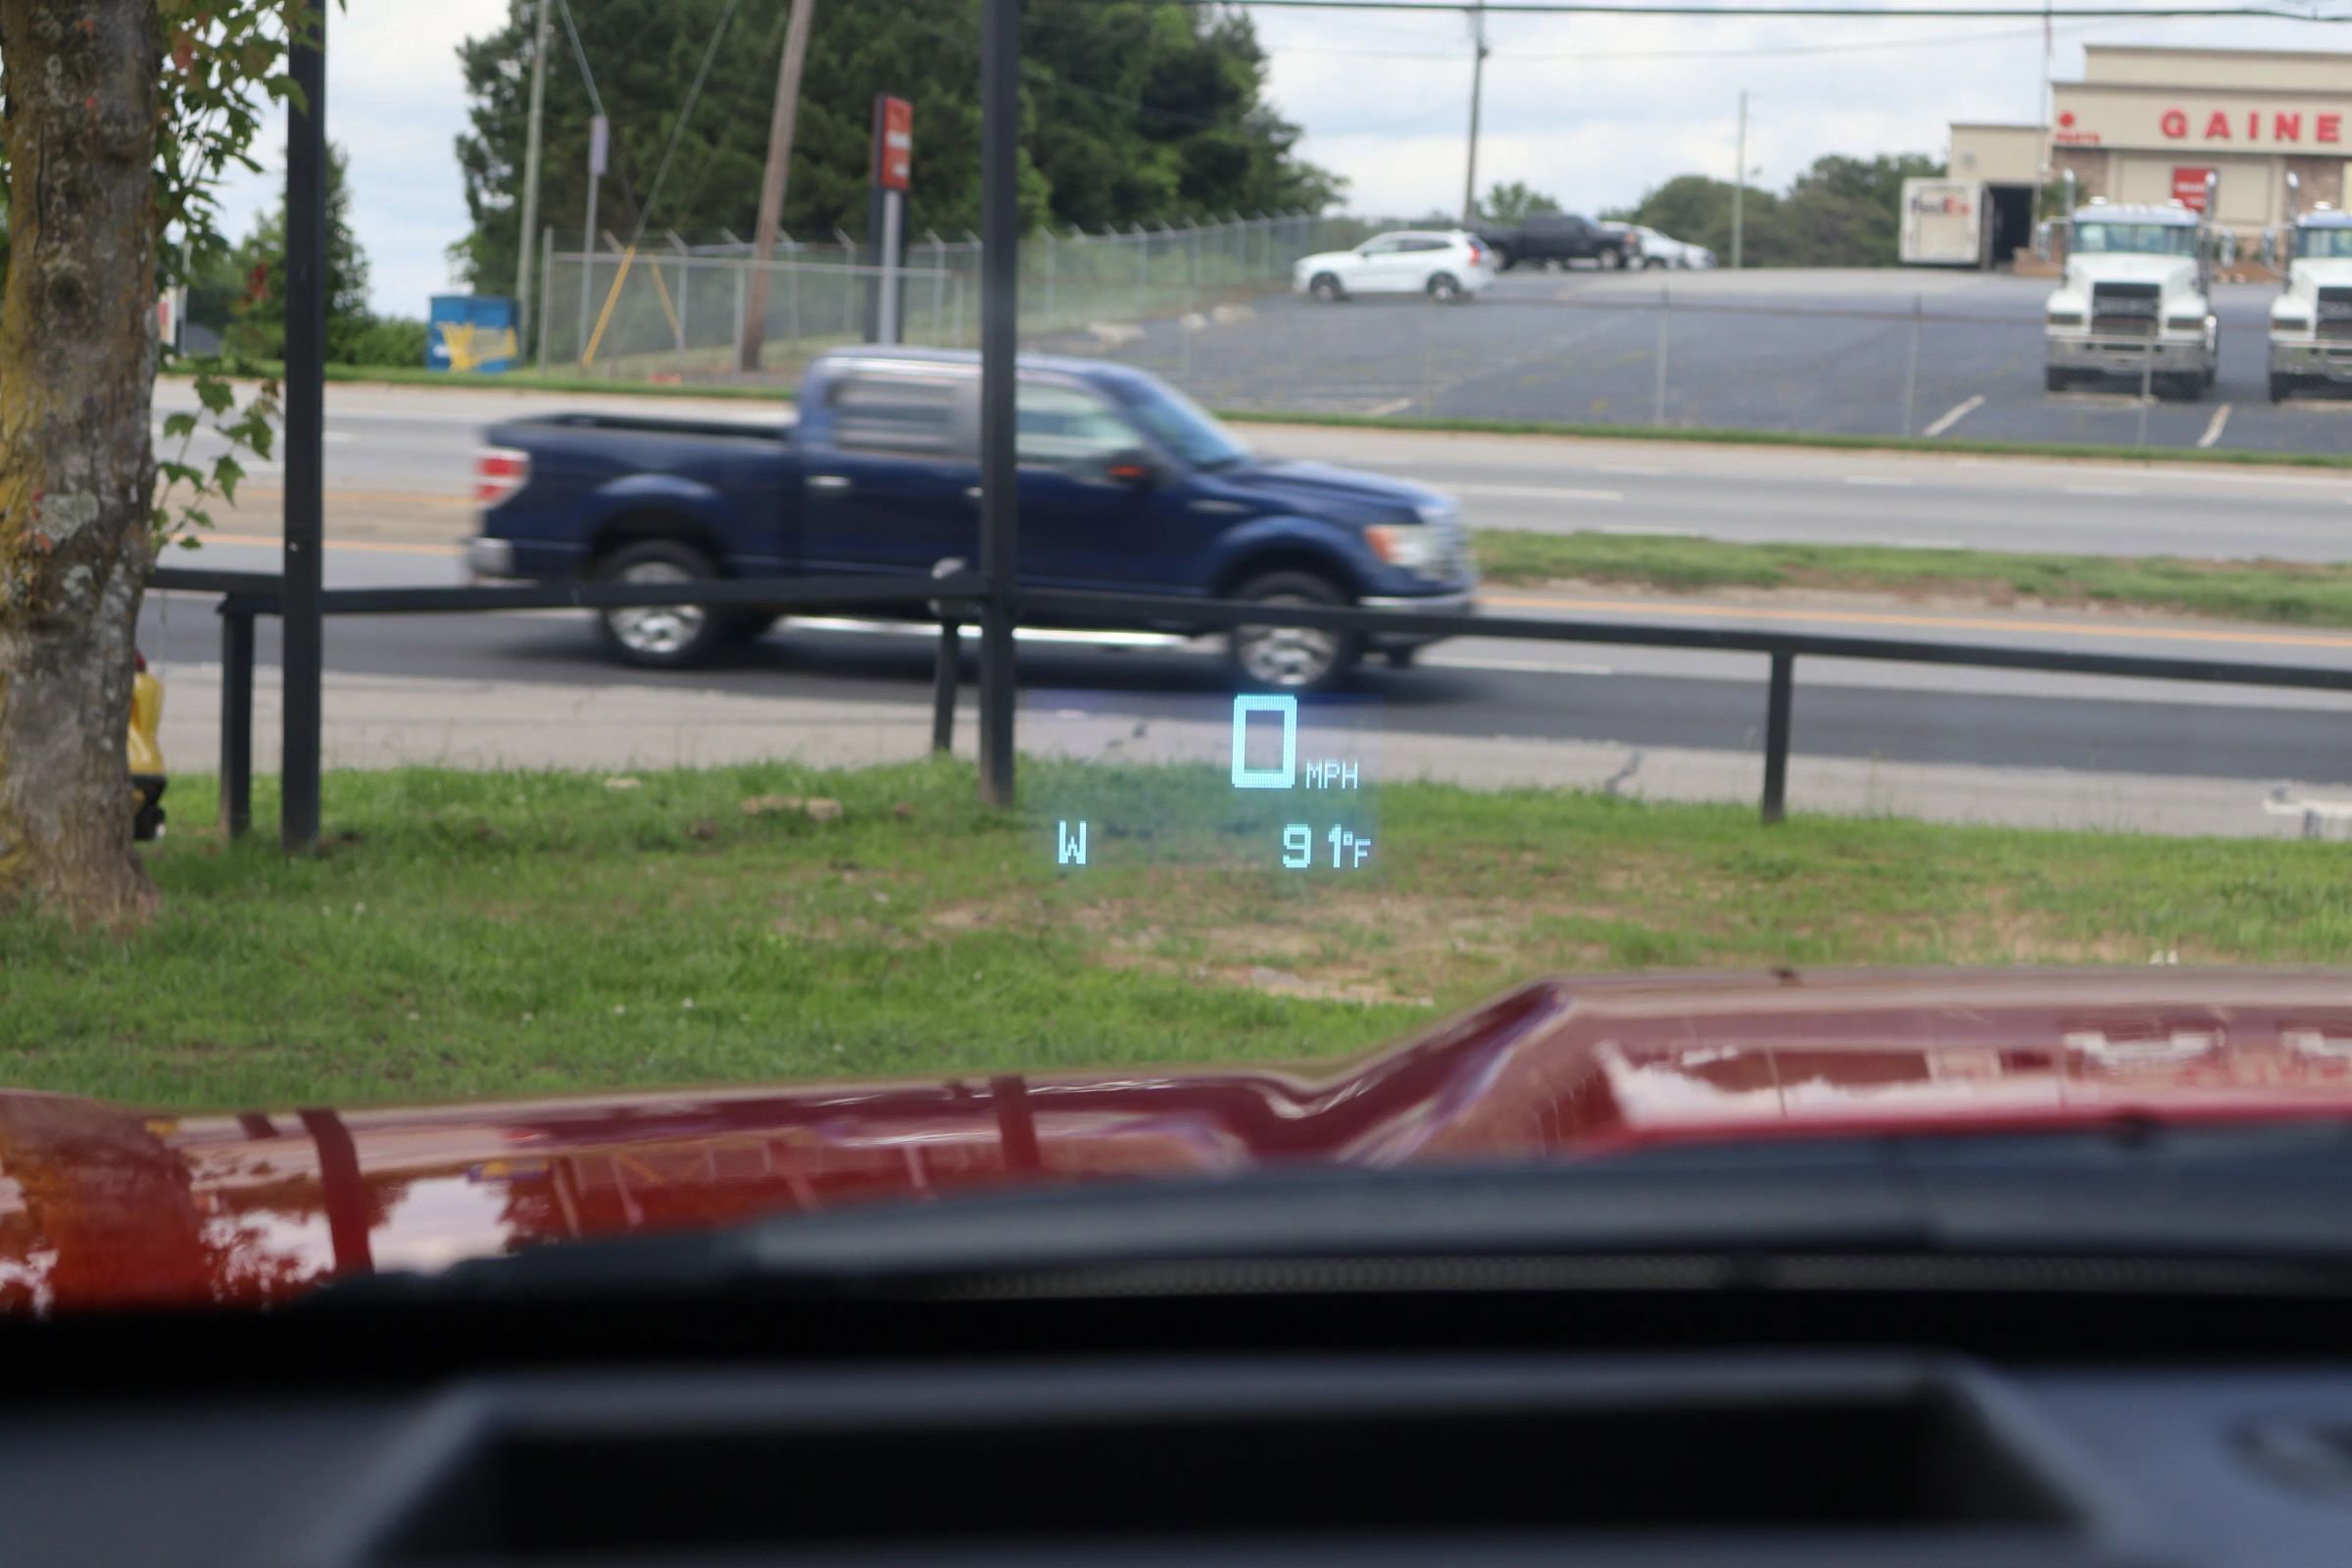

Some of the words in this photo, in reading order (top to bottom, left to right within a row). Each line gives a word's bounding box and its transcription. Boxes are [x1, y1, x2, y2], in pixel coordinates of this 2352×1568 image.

[1232, 693, 1298, 789] 0
[1305, 760, 1358, 789] MPH
[1058, 820, 1087, 864] W
